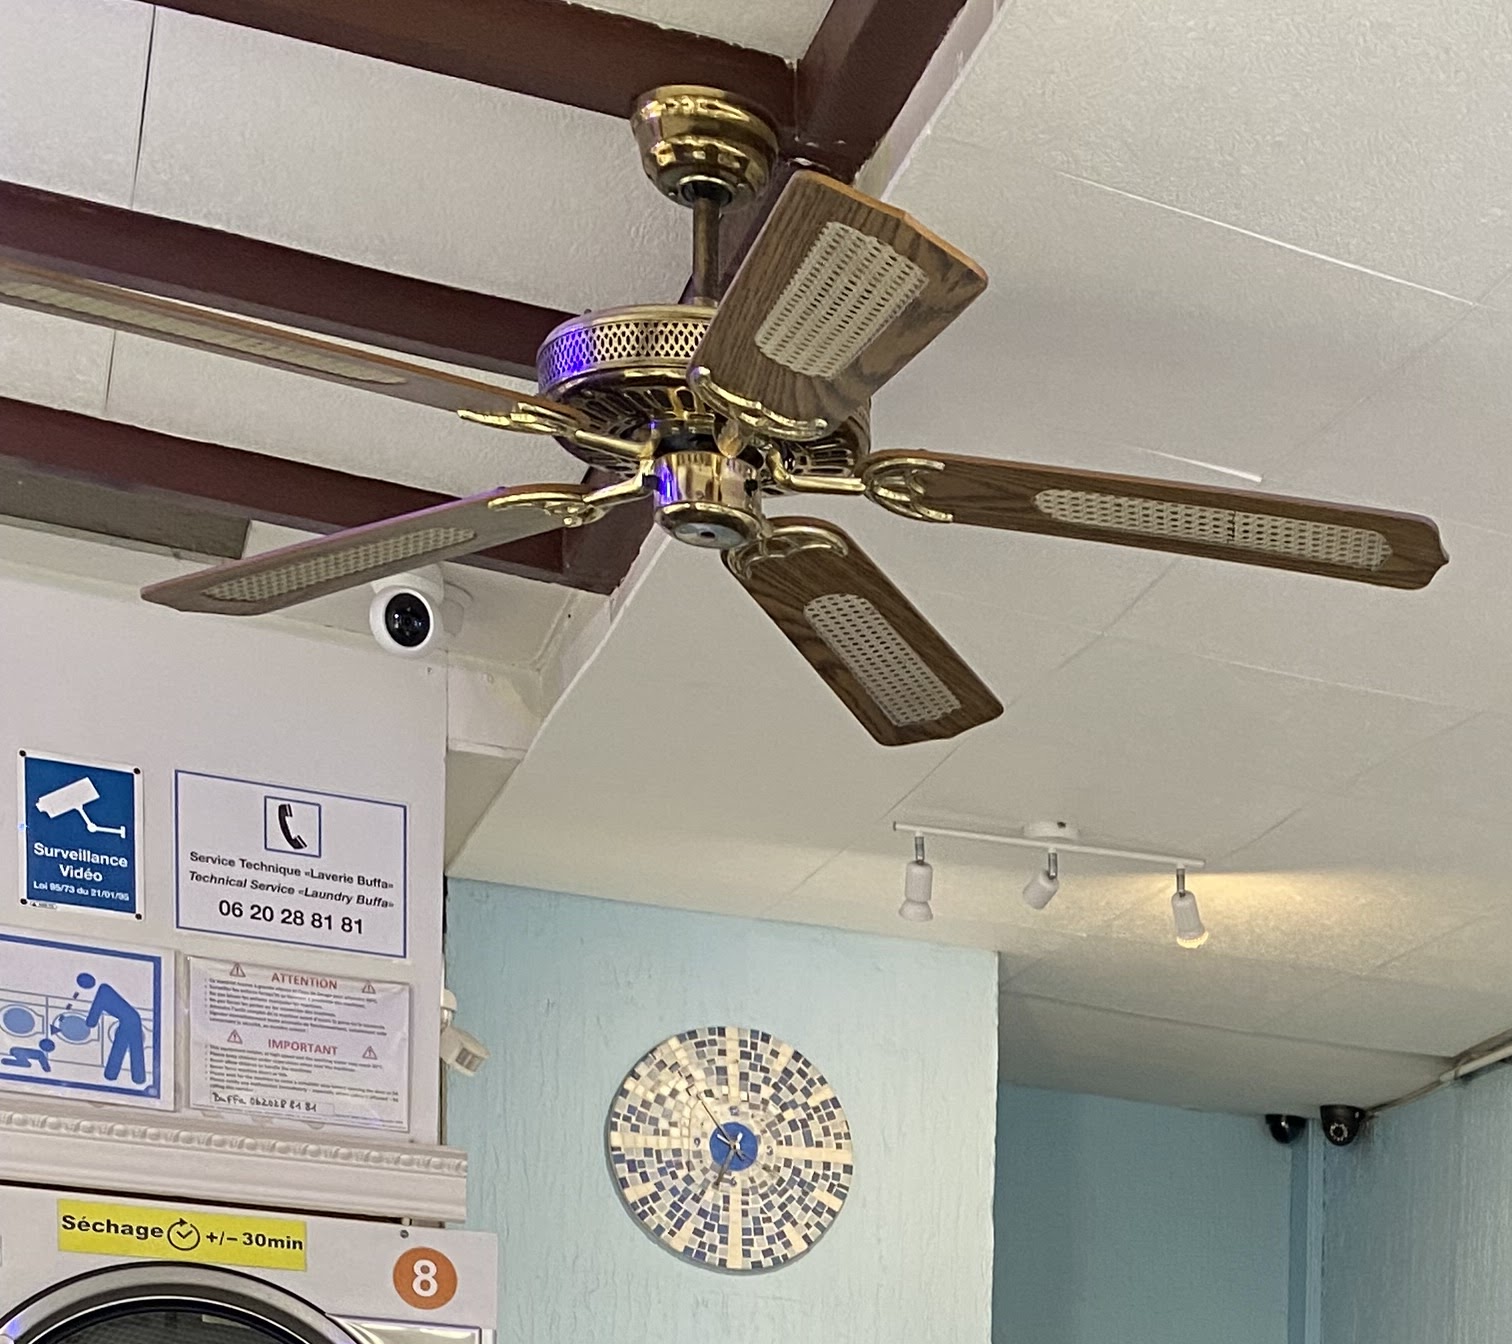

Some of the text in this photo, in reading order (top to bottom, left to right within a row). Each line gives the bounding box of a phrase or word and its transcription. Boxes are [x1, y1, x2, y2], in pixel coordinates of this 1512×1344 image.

[34, 842, 128, 867] Surveillance
[190, 851, 235, 867] Service
[239, 858, 300, 876] Technique
[59, 865, 102, 881] Vidéo
[189, 871, 247, 888] Technical
[250, 880, 294, 894] Service
[77, 887, 88, 895] du
[219, 900, 362, 934] 06 20 28 81 81
[271, 973, 337, 989] ATTENTION
[268, 1039, 337, 1055] IMPORTANT
[61, 1214, 163, 1241] Séchage
[242, 1232, 303, 1251] 30min
[412, 1259, 438, 1297] 8
